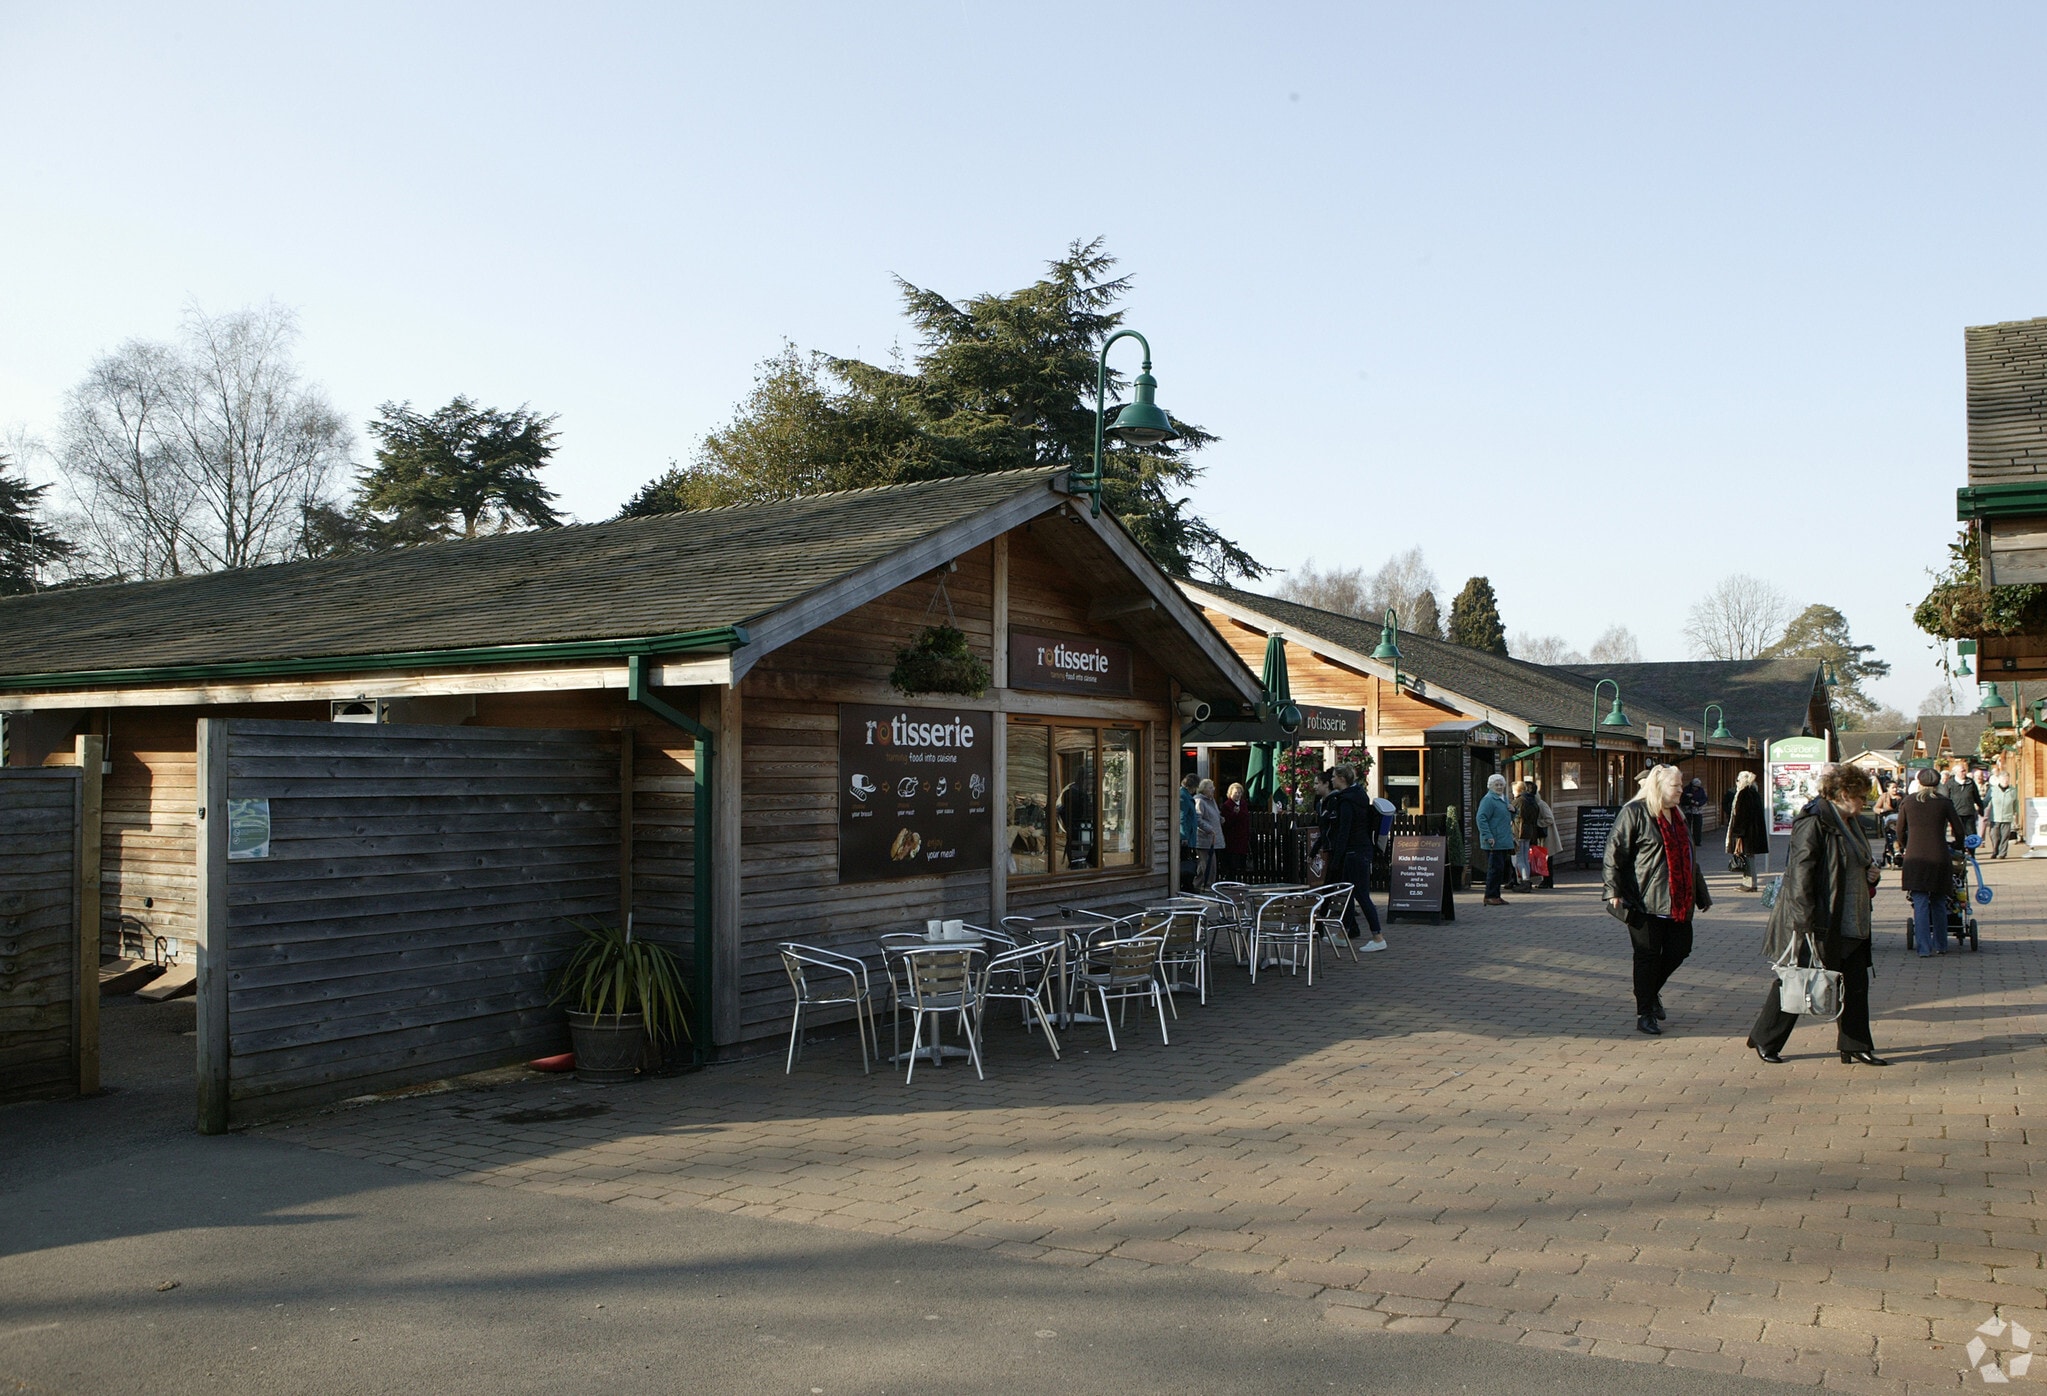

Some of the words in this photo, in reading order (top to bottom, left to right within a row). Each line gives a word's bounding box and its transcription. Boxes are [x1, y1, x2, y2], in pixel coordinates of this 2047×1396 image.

[1036, 643, 1109, 673] rotisserie
[865, 713, 974, 748] rotisserie
[1307, 712, 1347, 731] rotisserie
[909, 752, 923, 762] food
[925, 753, 935, 762] into
[937, 753, 957, 763] cuisine
[927, 850, 940, 861] your
